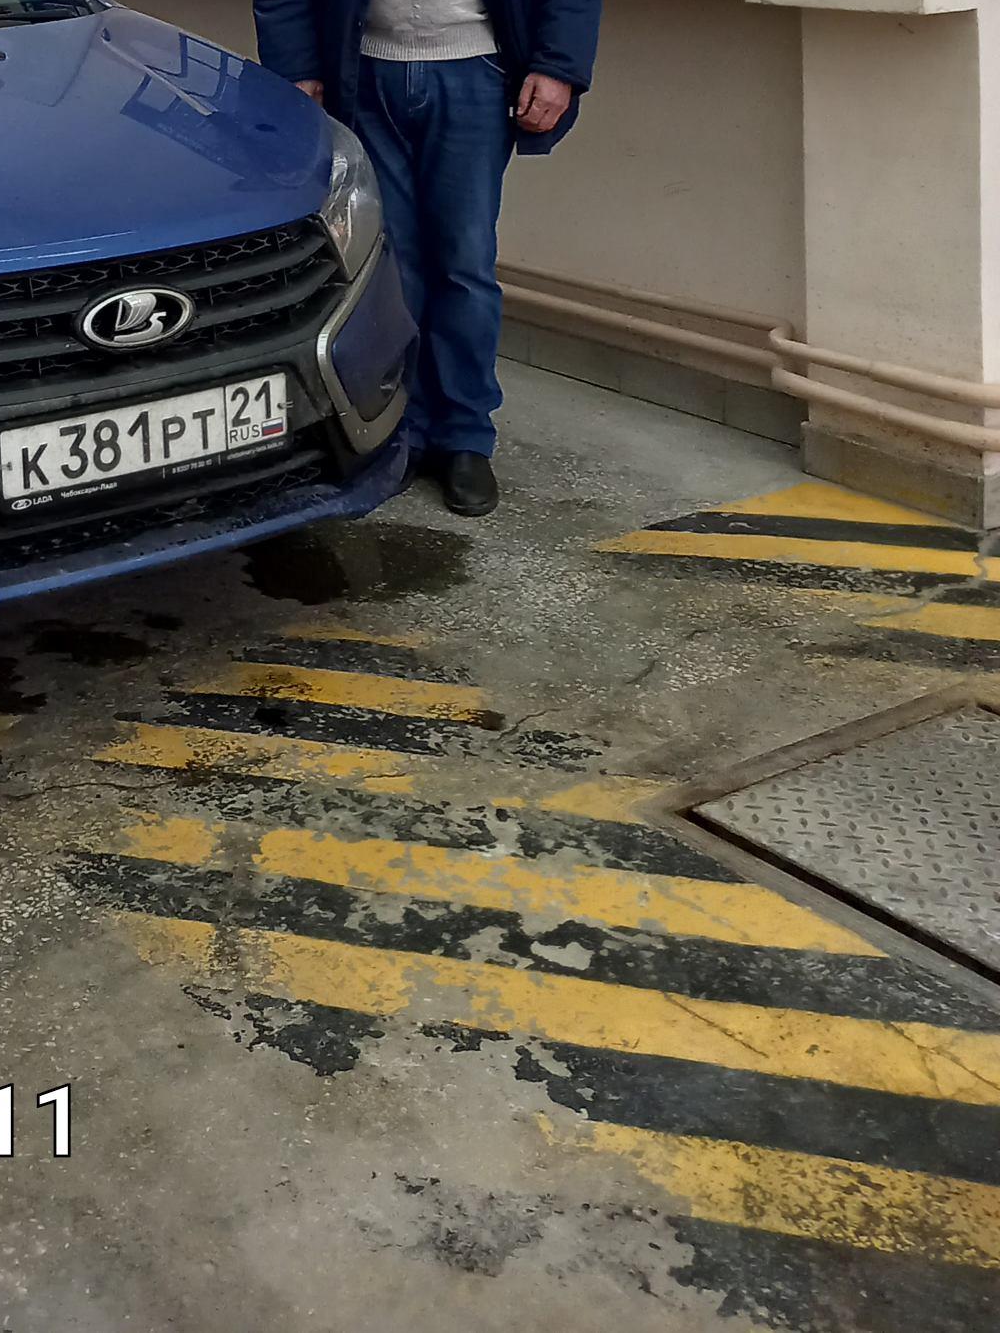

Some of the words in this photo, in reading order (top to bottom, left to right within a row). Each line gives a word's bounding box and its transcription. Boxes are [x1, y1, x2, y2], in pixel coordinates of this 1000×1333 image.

[230, 380, 272, 427] 21
[229, 424, 261, 444] RUS
[32, 495, 53, 506] LADA
